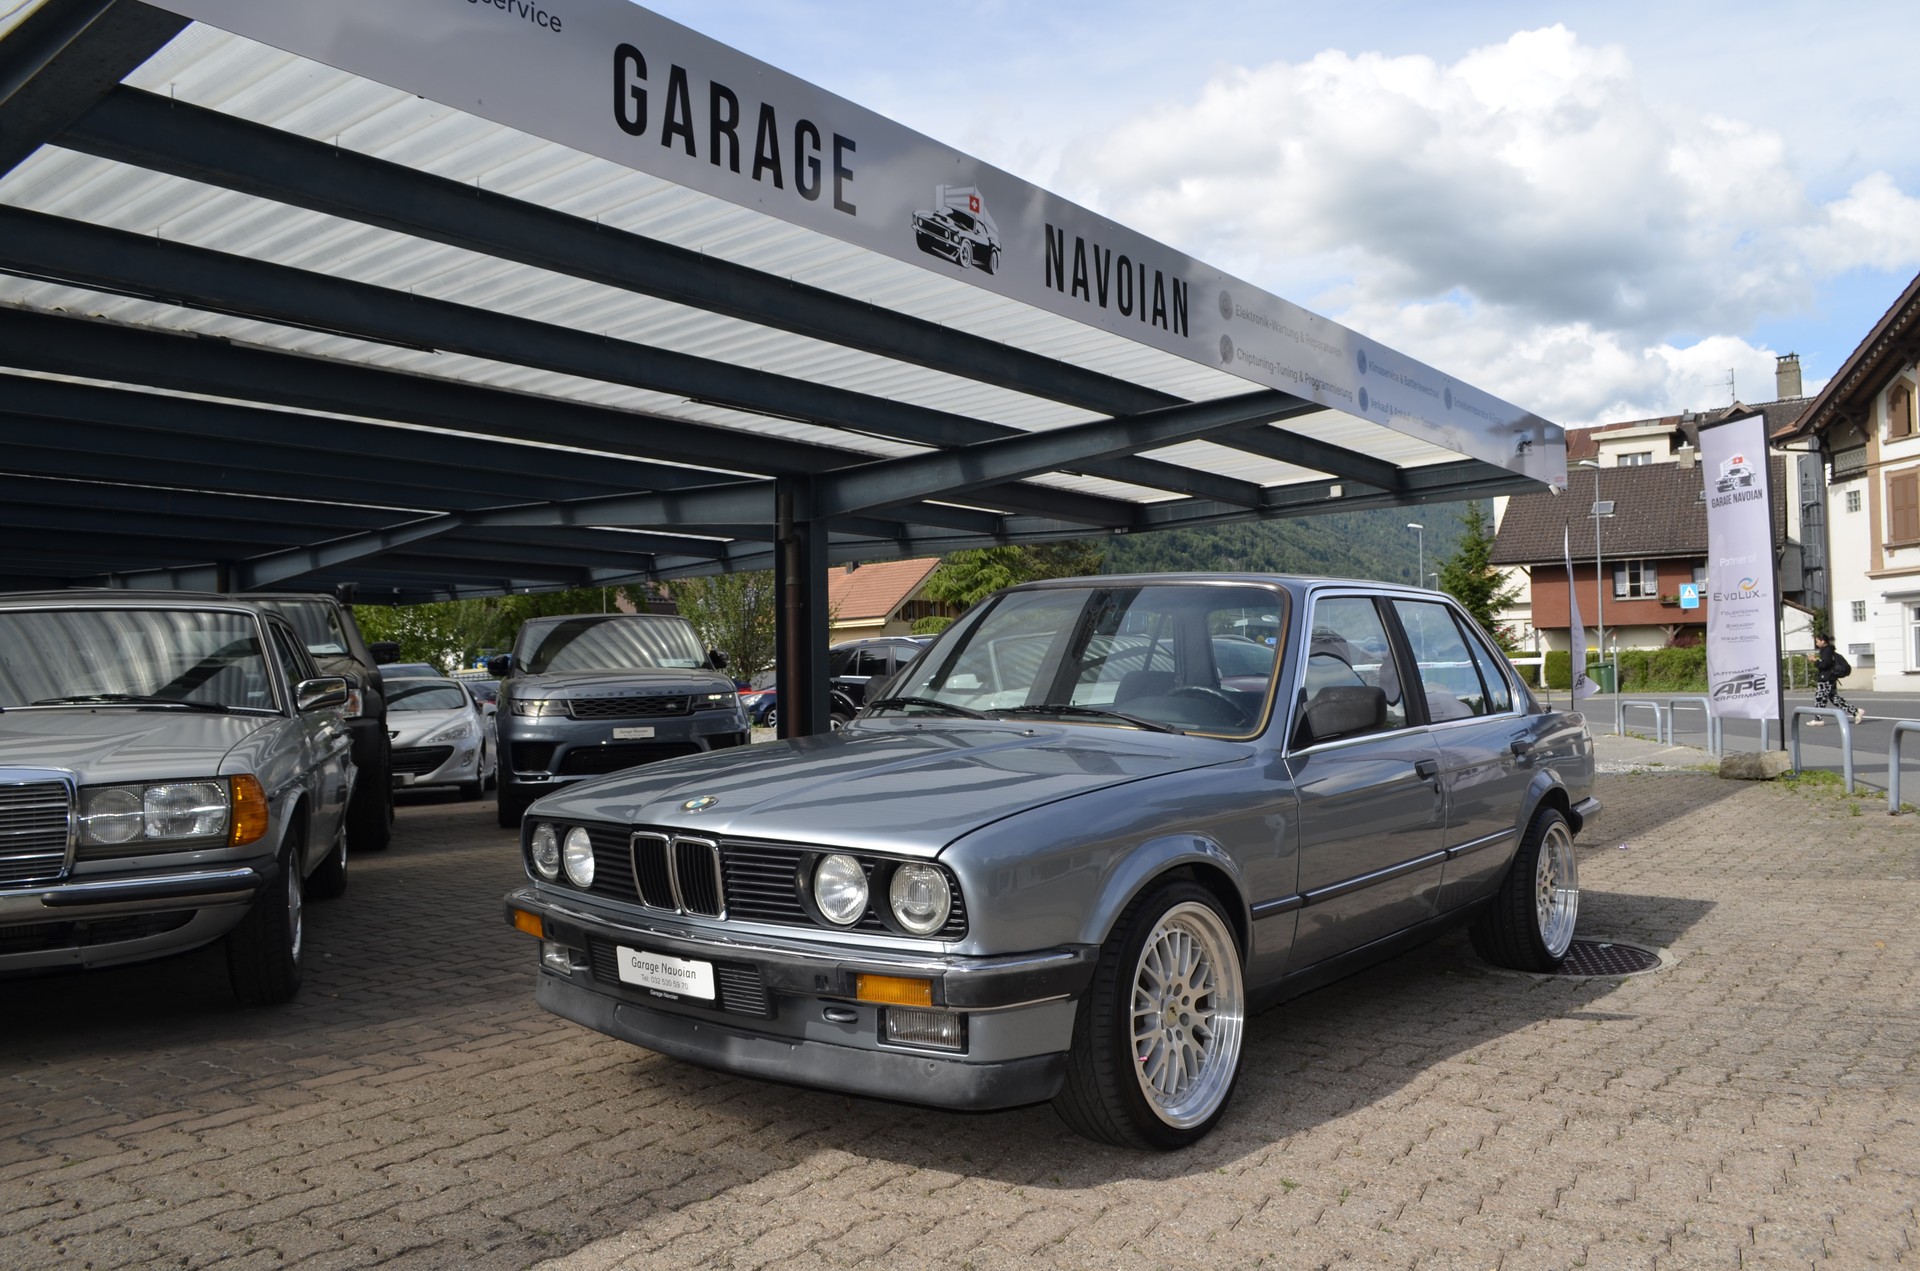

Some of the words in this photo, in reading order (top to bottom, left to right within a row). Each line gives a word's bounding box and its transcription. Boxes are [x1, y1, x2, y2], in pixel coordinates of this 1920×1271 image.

[613, 42, 857, 217] GARAGE
[1045, 223, 1189, 338] NAVOIAN
[1236, 348, 1298, 383] Chiptuning-Tuning
[1711, 494, 1732, 508] GARAGE
[1732, 488, 1763, 503] NAVOIAN
[1719, 555, 1745, 568] Partner
[1713, 677, 1766, 697] APE
[631, 956, 659, 974] Garage
[661, 962, 697, 980] Navoian
[650, 975, 661, 985] 032
[661, 978, 672, 987] 530
[681, 982, 689, 990] 70
